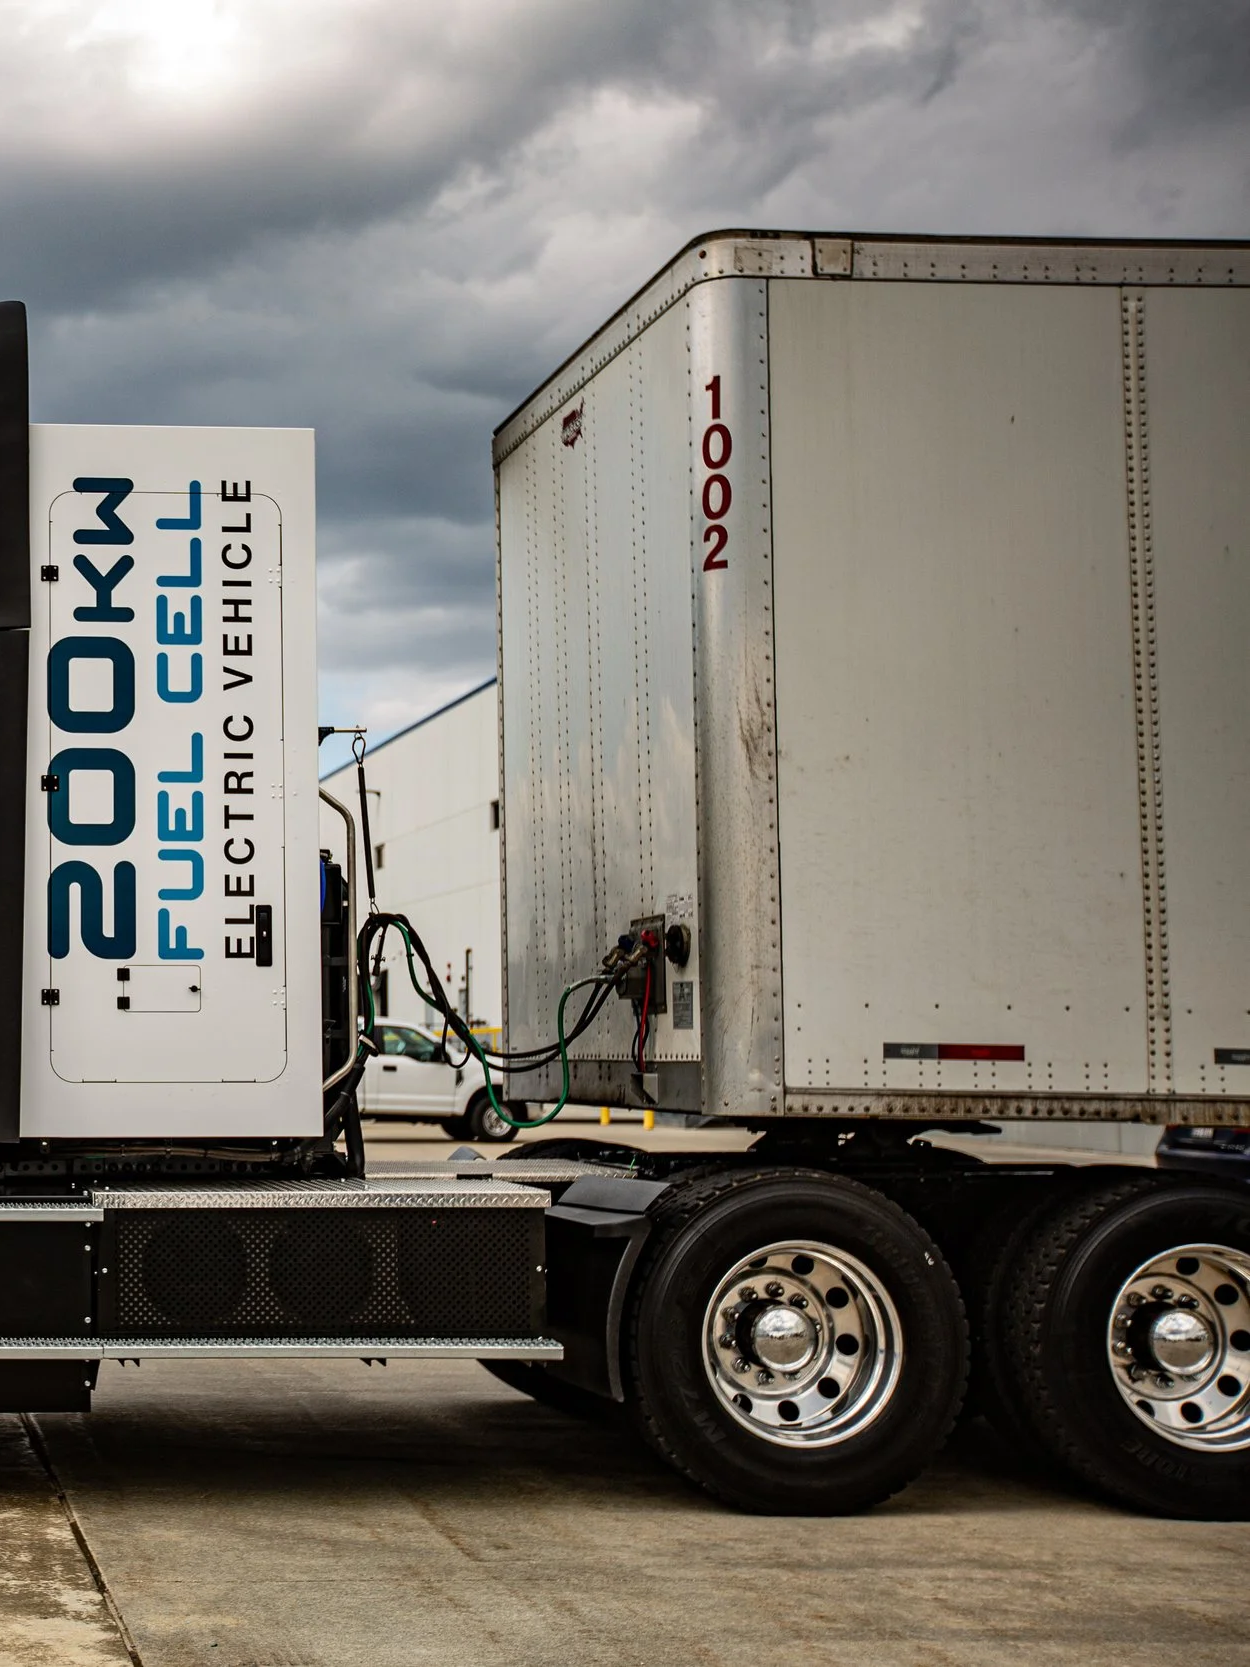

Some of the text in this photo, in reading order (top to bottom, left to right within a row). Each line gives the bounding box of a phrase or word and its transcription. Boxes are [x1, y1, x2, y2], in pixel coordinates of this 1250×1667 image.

[702, 375, 732, 572] 1002
[47, 477, 136, 960] 200KW
[156, 480, 205, 960] FUEL CELL
[221, 480, 255, 959] ELECTRIC VEHICLE
